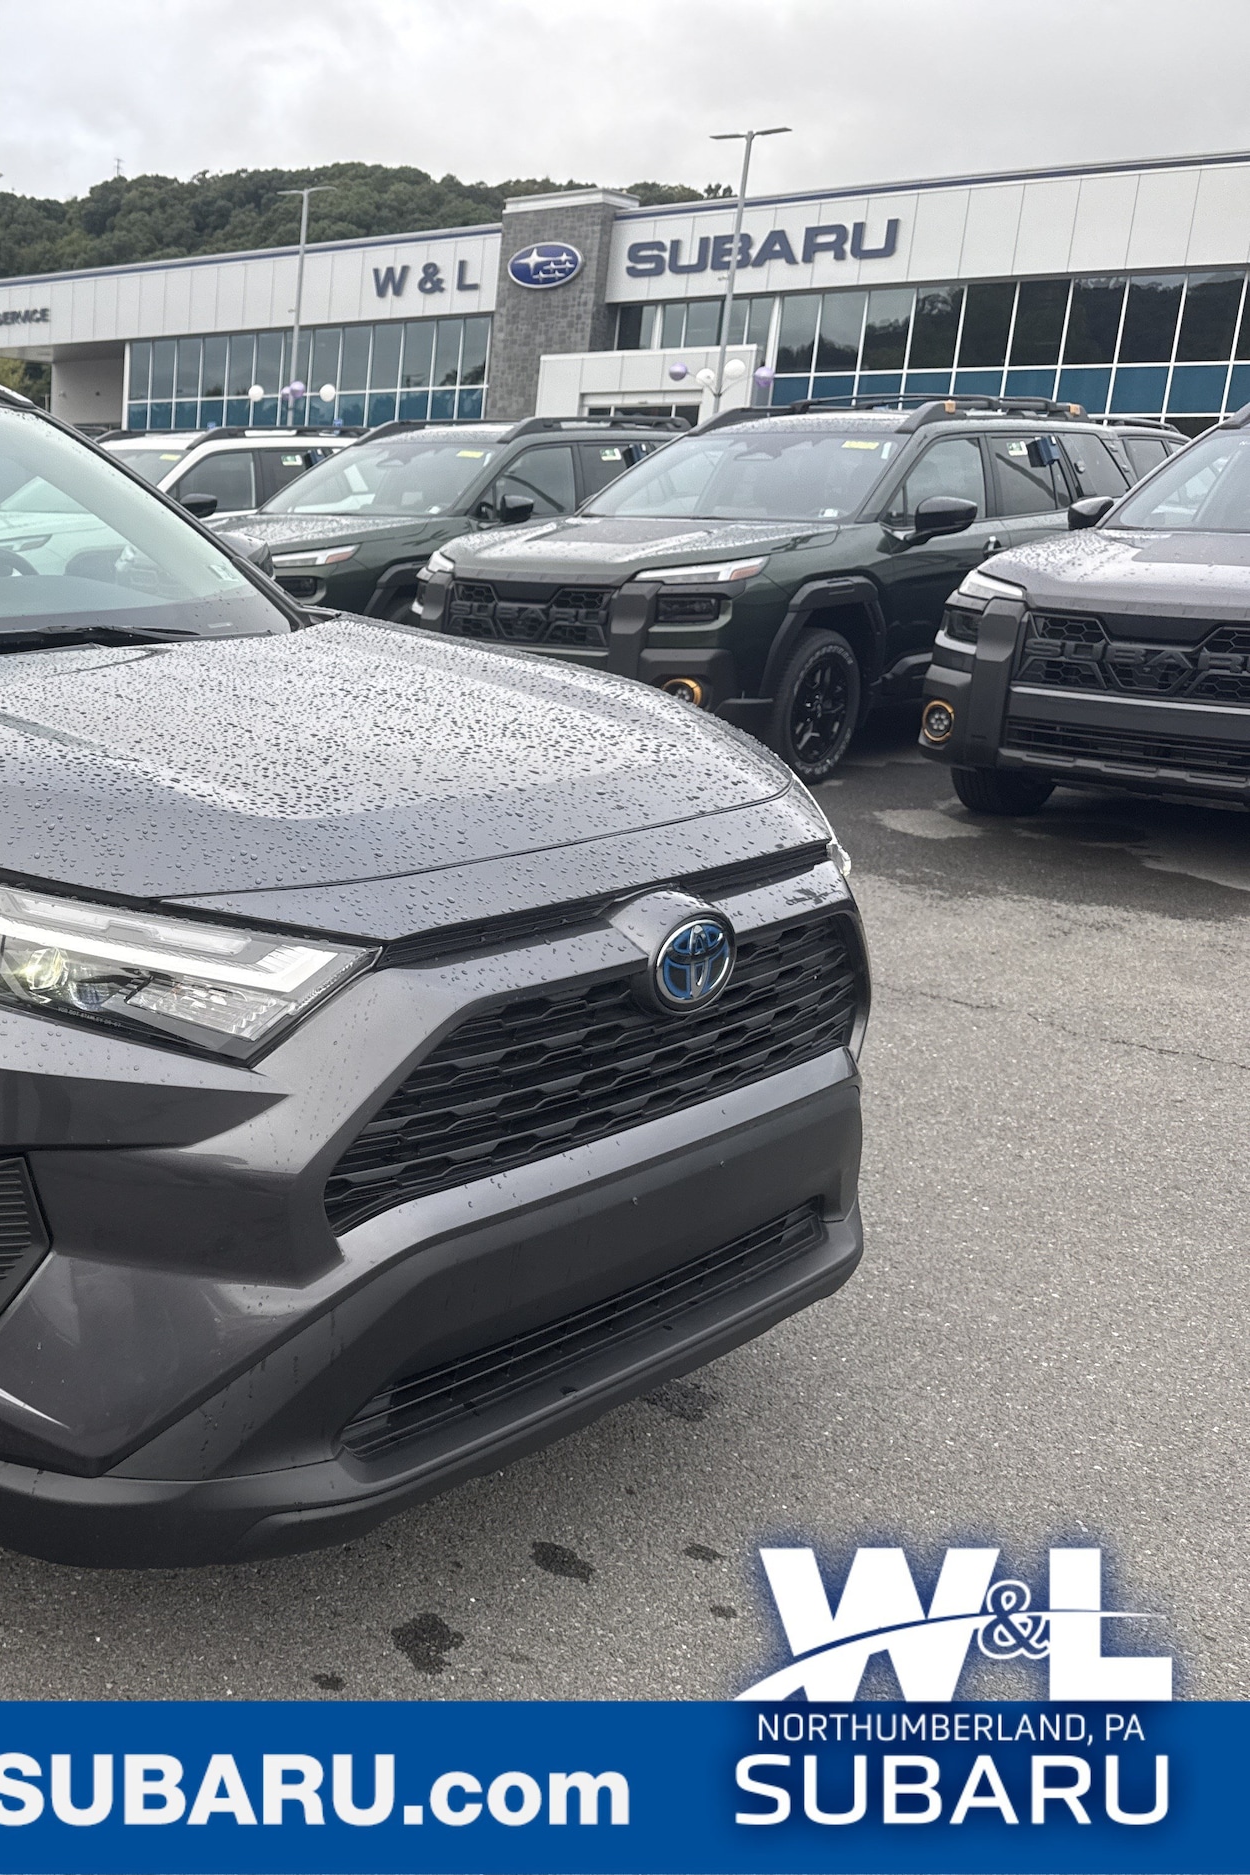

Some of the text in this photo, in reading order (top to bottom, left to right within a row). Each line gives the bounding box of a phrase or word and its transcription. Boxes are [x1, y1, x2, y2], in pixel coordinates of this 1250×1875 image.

[625, 218, 900, 279] SUBARU
[373, 260, 480, 299] W & L
[450, 601, 610, 625] SUBARU
[1025, 637, 1250, 675] SUBAR
